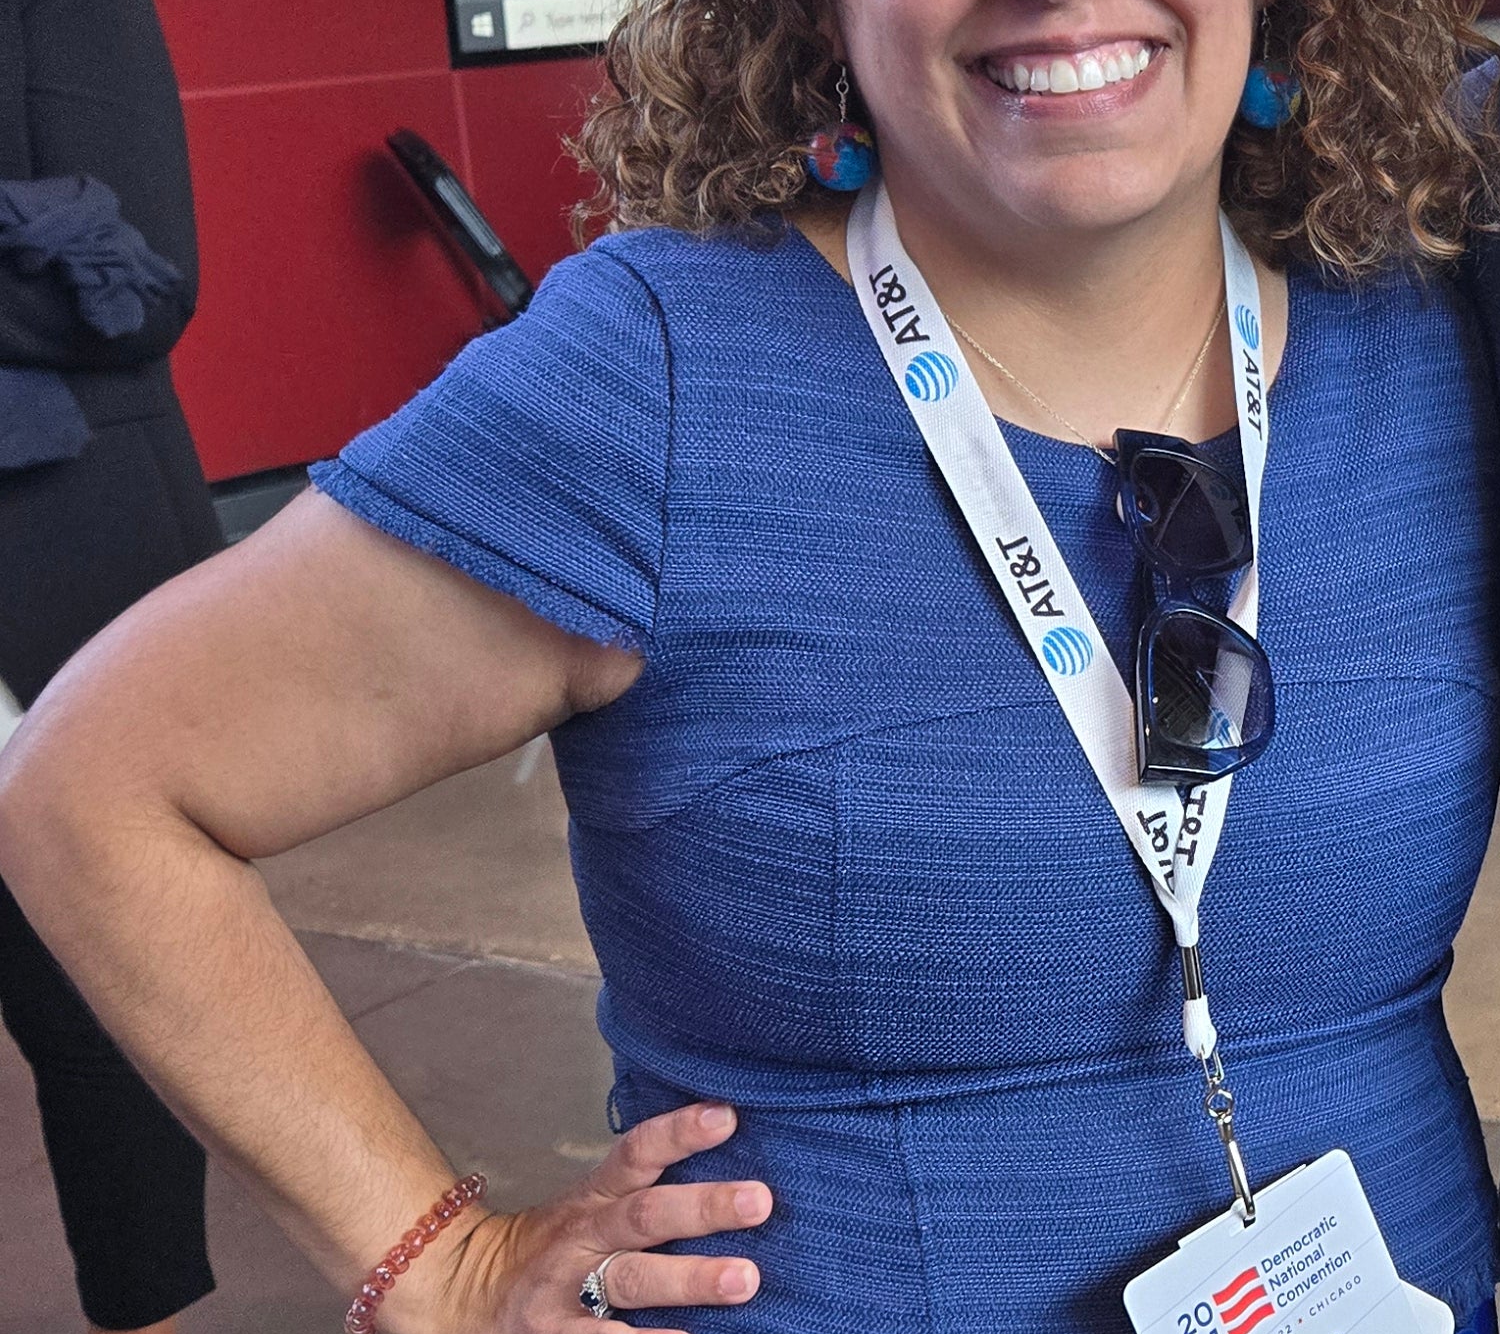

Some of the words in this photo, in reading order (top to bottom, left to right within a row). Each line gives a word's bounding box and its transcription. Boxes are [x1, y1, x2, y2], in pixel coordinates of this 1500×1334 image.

[868, 264, 931, 345] AT&T
[1242, 349, 1264, 441] AT&T
[995, 535, 1065, 618] AT&T
[1176, 790, 1207, 866] T&T
[1261, 1213, 1338, 1274] Democratic
[1268, 1244, 1327, 1292] National
[1276, 1249, 1353, 1308] Convention
[1309, 1275, 1362, 1317] CHICAGO
